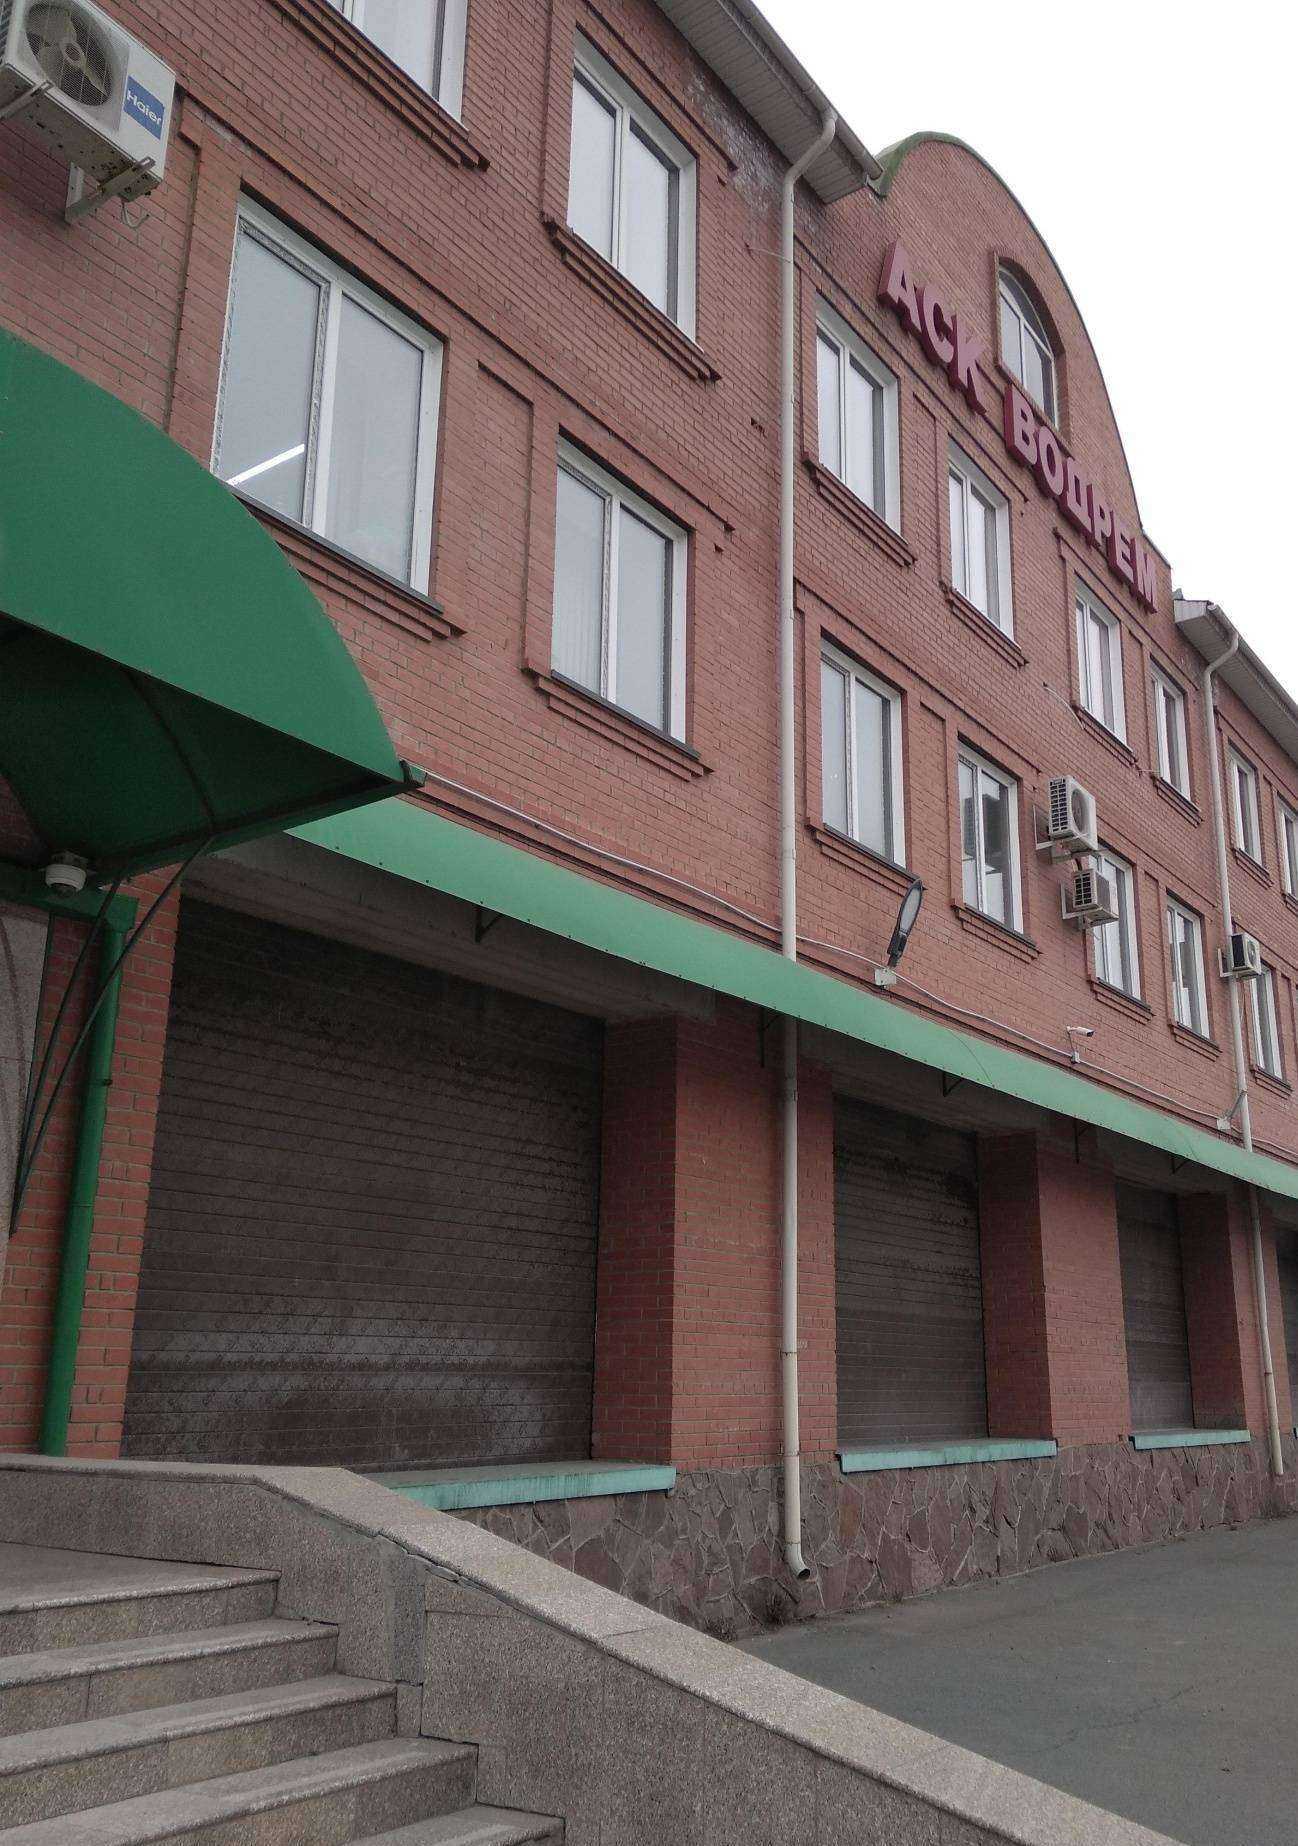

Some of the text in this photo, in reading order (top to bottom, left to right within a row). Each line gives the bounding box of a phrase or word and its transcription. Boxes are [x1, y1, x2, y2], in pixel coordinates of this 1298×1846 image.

[126, 89, 162, 125] Haier
[879, 236, 1157, 613] АСК ВОДРЕМ
